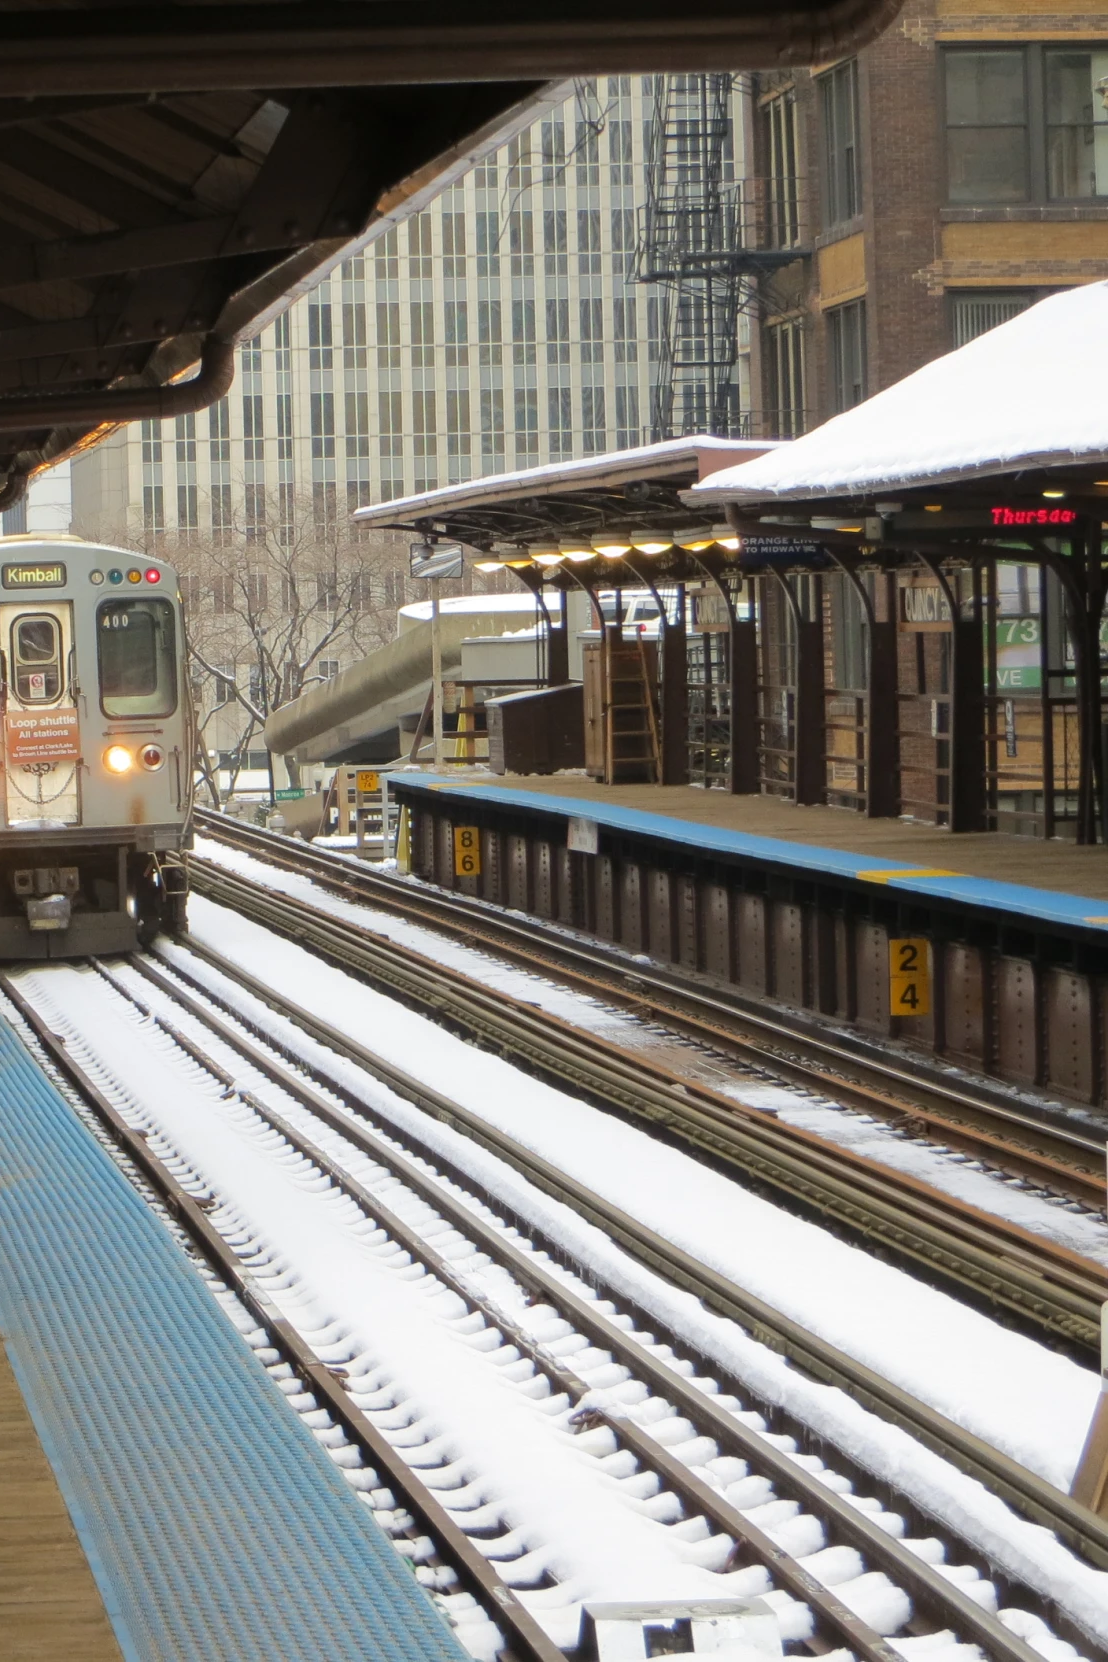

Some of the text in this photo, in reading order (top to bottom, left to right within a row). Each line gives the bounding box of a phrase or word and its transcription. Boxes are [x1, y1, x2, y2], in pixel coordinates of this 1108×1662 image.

[991, 507, 1076, 525] Thursda
[742, 537, 789, 545] ORANGE
[7, 568, 62, 583] Kimball
[905, 588, 939, 621] QUINCY
[10, 715, 76, 729] Loop shuttle
[19, 729, 68, 739] All stations
[461, 831, 473, 848] 8
[461, 855, 474, 872] 6
[899, 944, 918, 971] 2
[900, 984, 919, 1009] 4
